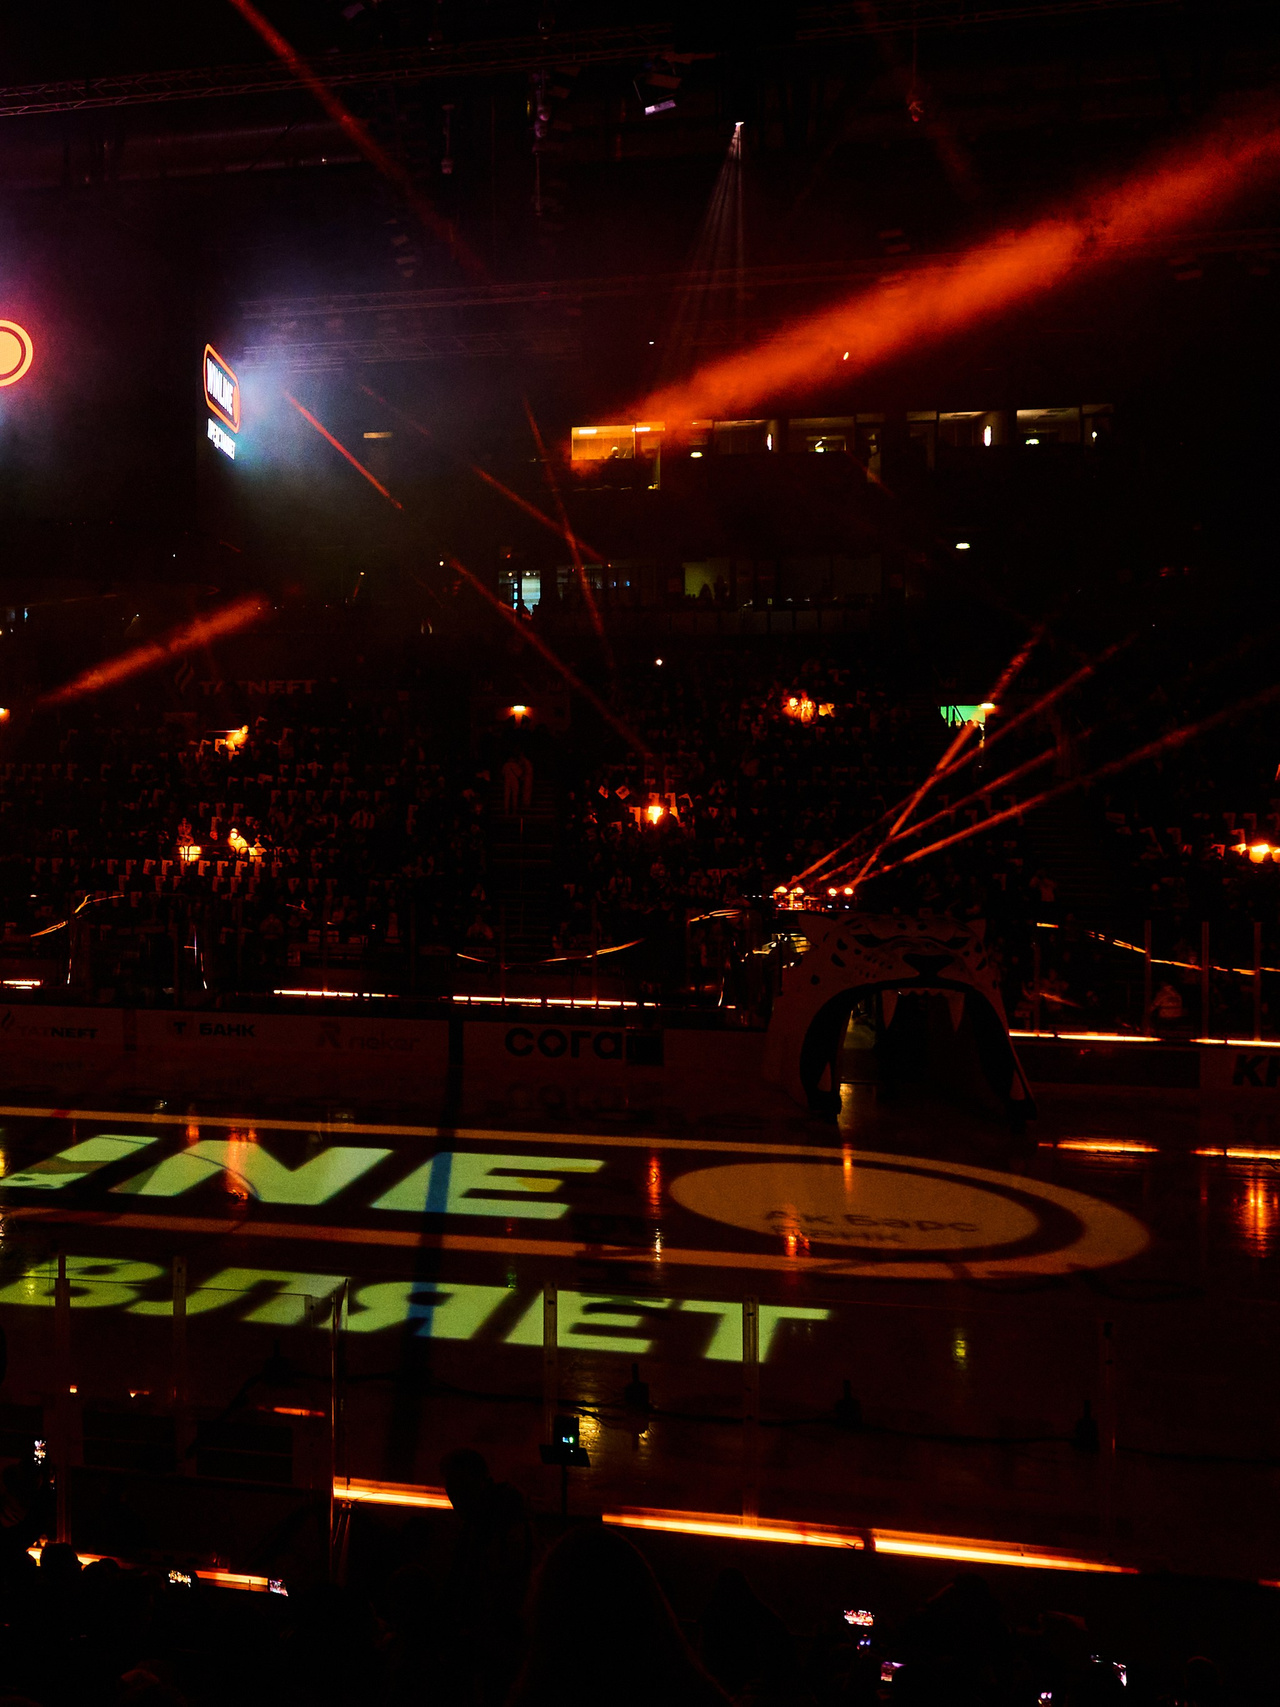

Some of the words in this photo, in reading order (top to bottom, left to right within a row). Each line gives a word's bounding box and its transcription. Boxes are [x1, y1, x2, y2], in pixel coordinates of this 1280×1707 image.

[20, 1025, 99, 1039] TATNEFT
[199, 1022, 256, 1037] БАНК
[504, 1026, 630, 1060] сога
